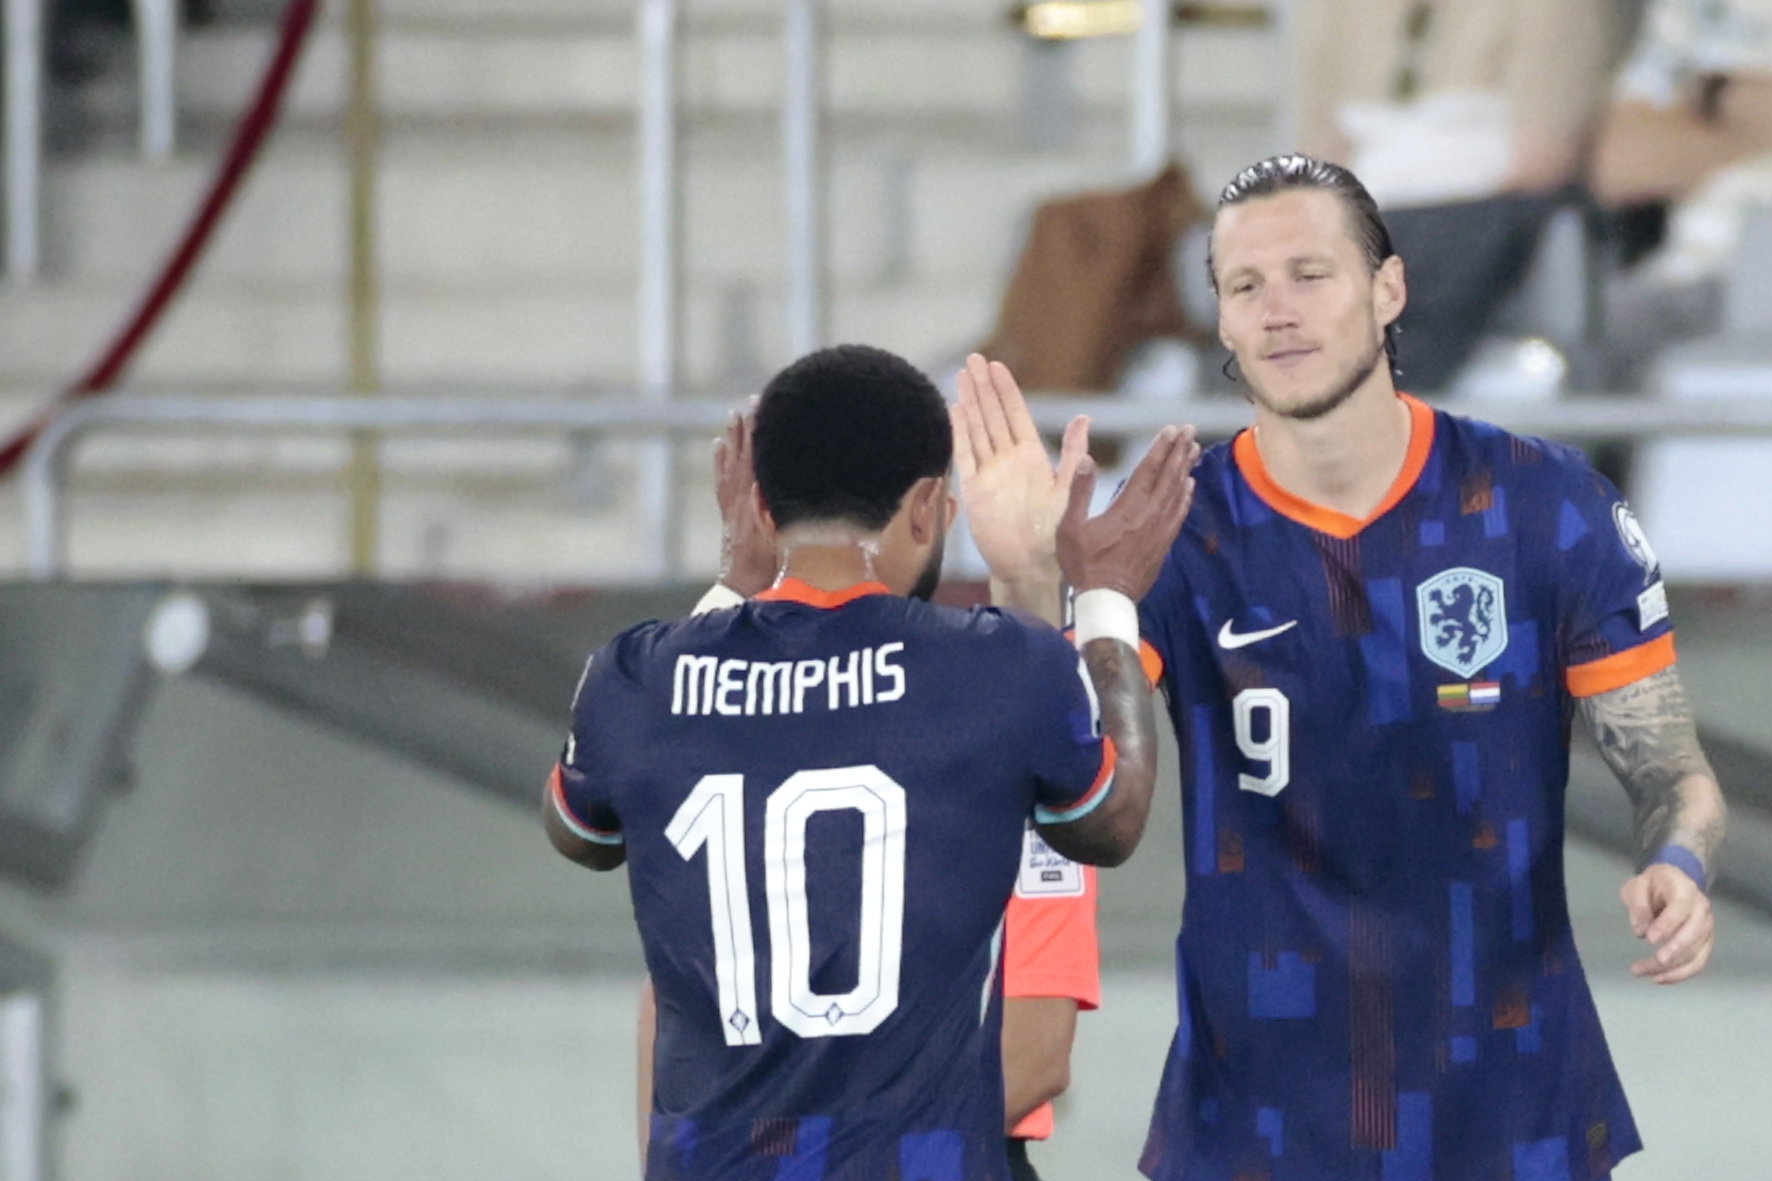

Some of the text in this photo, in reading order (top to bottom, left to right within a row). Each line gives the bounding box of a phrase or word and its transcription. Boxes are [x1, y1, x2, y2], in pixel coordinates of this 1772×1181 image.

[671, 642, 905, 715] MEMPHIS
[1233, 687, 1290, 797] 9
[664, 765, 907, 1047] 10
